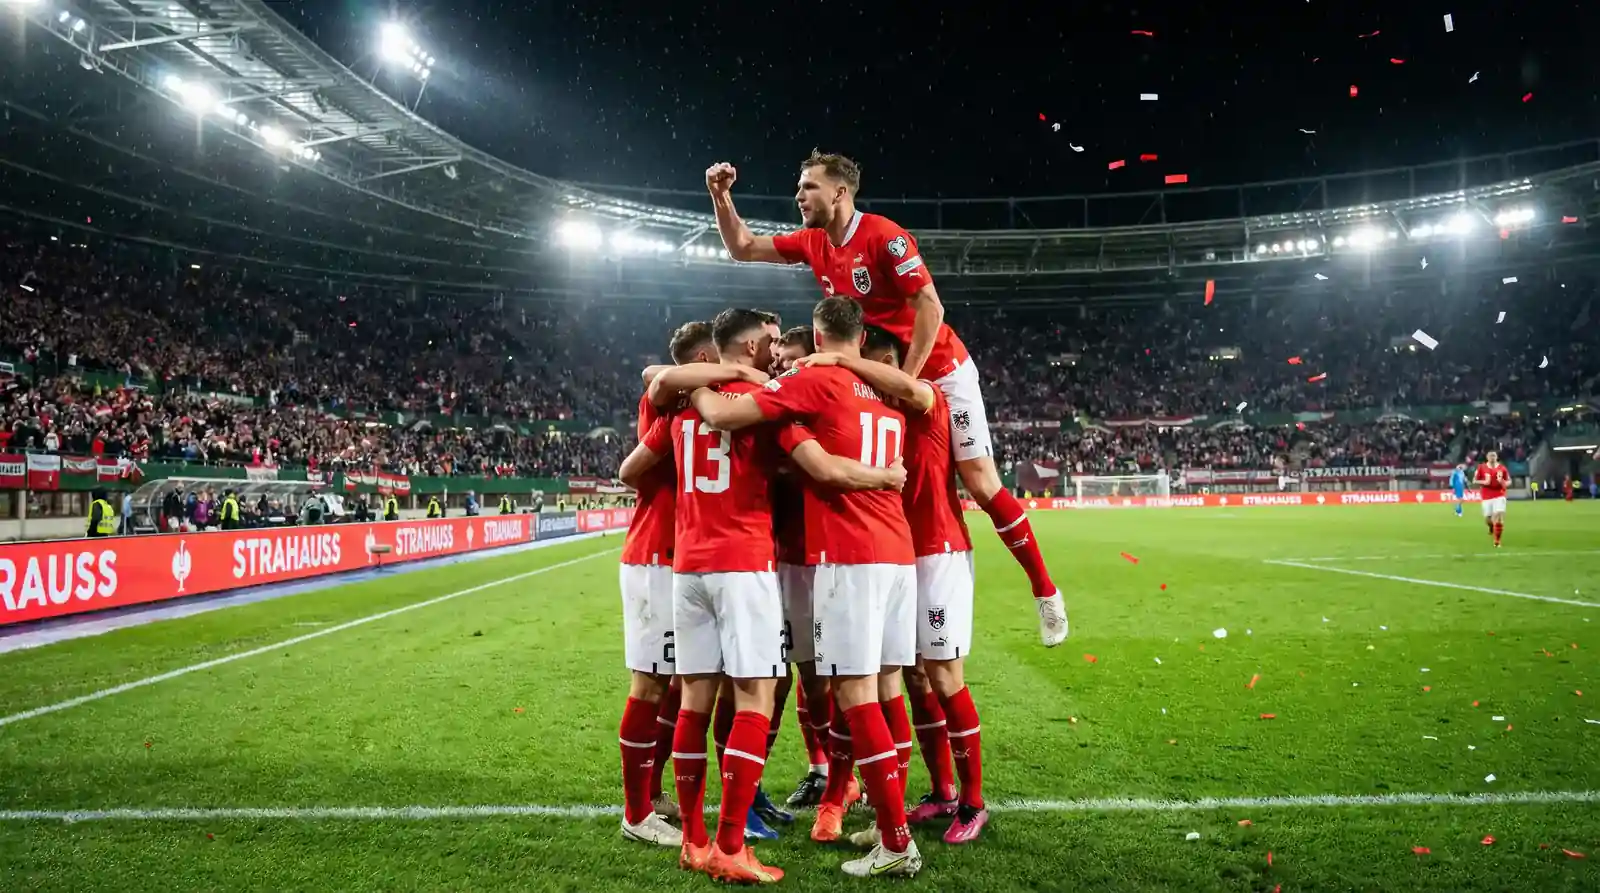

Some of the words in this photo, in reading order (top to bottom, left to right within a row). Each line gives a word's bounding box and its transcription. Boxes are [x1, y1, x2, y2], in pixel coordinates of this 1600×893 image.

[682, 419, 731, 494] 13
[860, 412, 902, 470] 10
[1341, 493, 1399, 504] STRAHAUSS
[233, 532, 341, 579] STRAHAUSS
[395, 524, 454, 556] STRAHAUSS
[484, 520, 522, 544] STRAHAUSS
[0, 550, 118, 611] RAUSS
